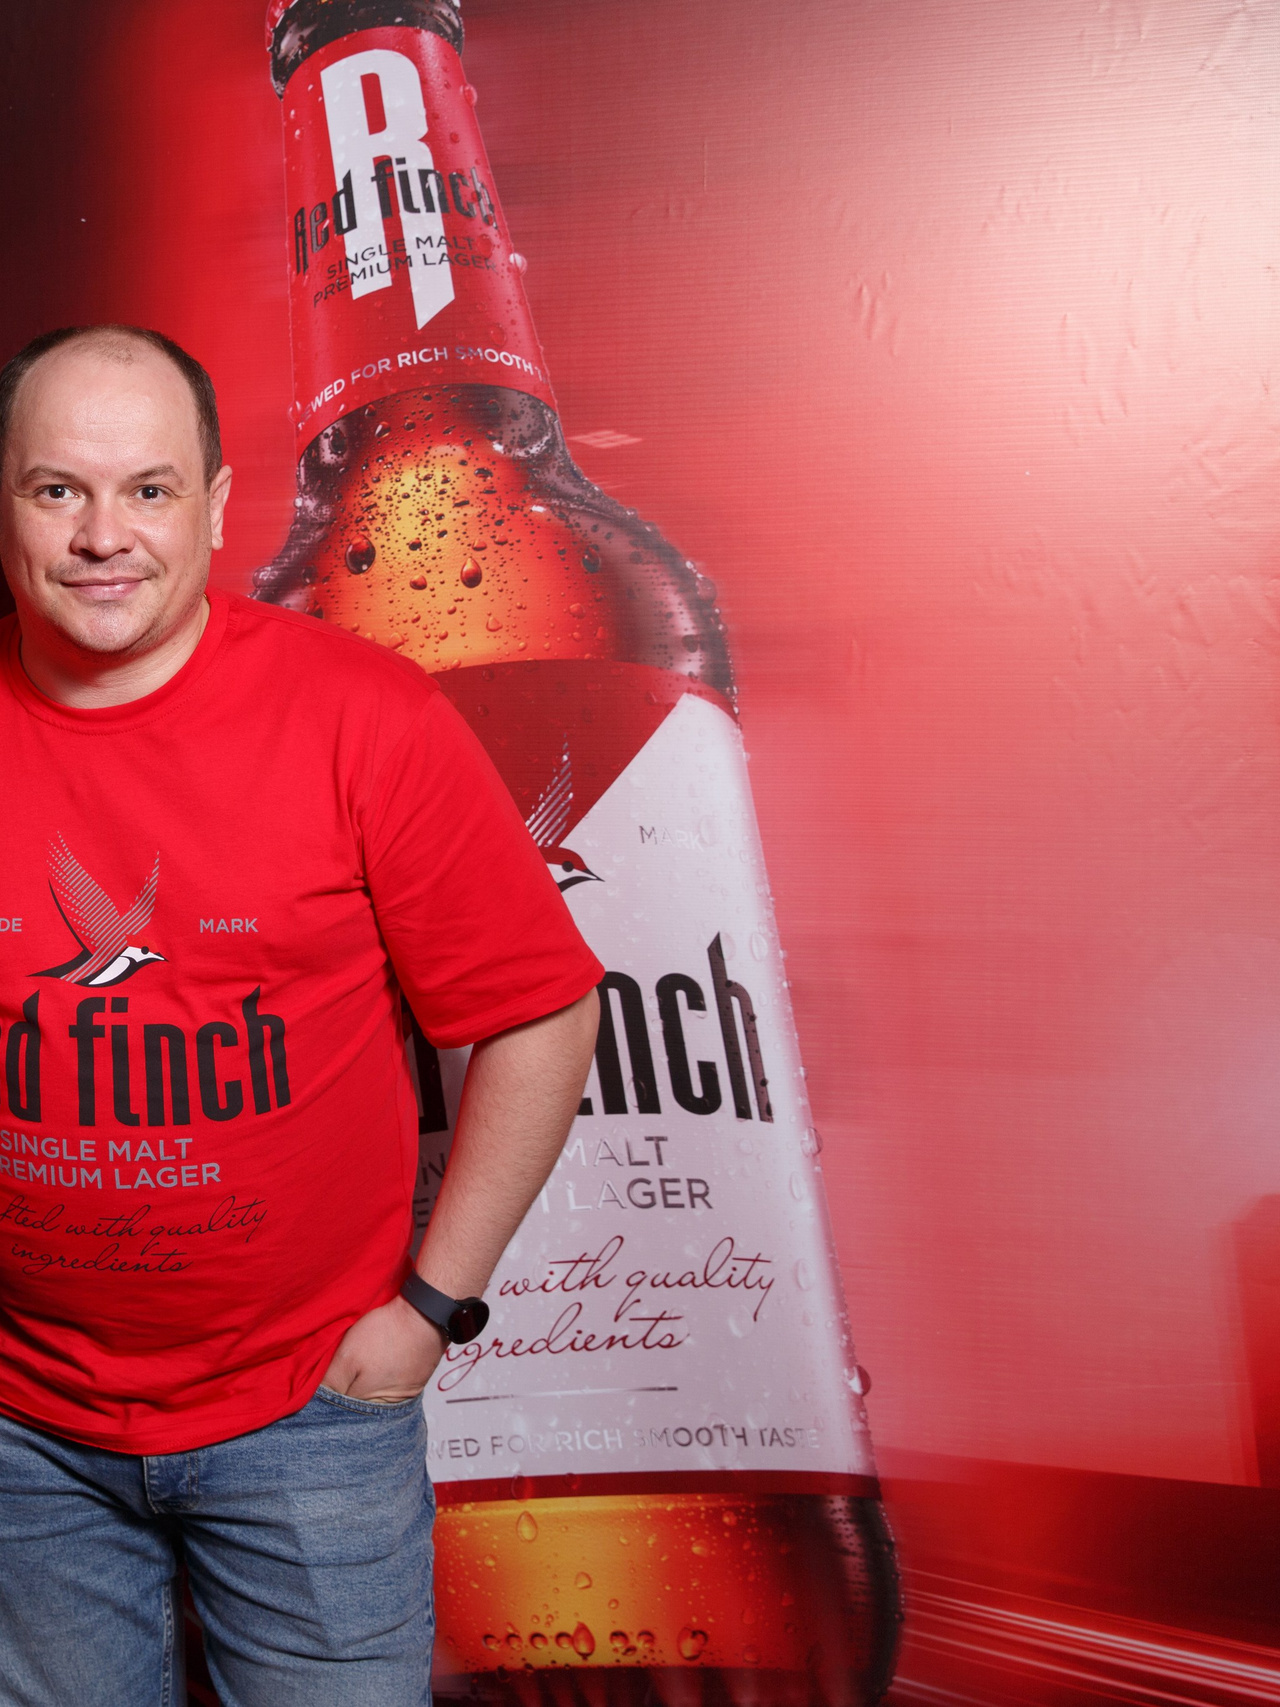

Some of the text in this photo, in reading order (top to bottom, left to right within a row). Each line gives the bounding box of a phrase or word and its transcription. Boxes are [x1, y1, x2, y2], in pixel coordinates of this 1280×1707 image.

[320, 49, 455, 330] R
[294, 157, 499, 276] Red finch
[327, 235, 474, 280] SINGLE MALT
[313, 252, 499, 308] PREMIUM LAGER
[350, 358, 391, 385] FOR
[397, 346, 449, 368] RICH
[455, 347, 534, 376] SMOOTH
[639, 825, 705, 852] MARK
[199, 917, 259, 934] MARK
[577, 931, 774, 1124] nch
[68, 984, 292, 1127] finch
[0, 1129, 193, 1162] SINGLE MALT
[557, 1135, 669, 1168] MALT
[114, 1161, 222, 1190] LAGER
[568, 1177, 714, 1212] LAGER
[65, 1204, 144, 1238] with
[141, 1195, 267, 1256] quality
[11, 1242, 193, 1275] ingredients
[499, 1235, 775, 1323] with quality
[490, 1434, 546, 1456] FOR
[555, 1429, 624, 1452] RICH
[634, 1424, 749, 1448] SMOOTH
[759, 1427, 820, 1449] TASTE
